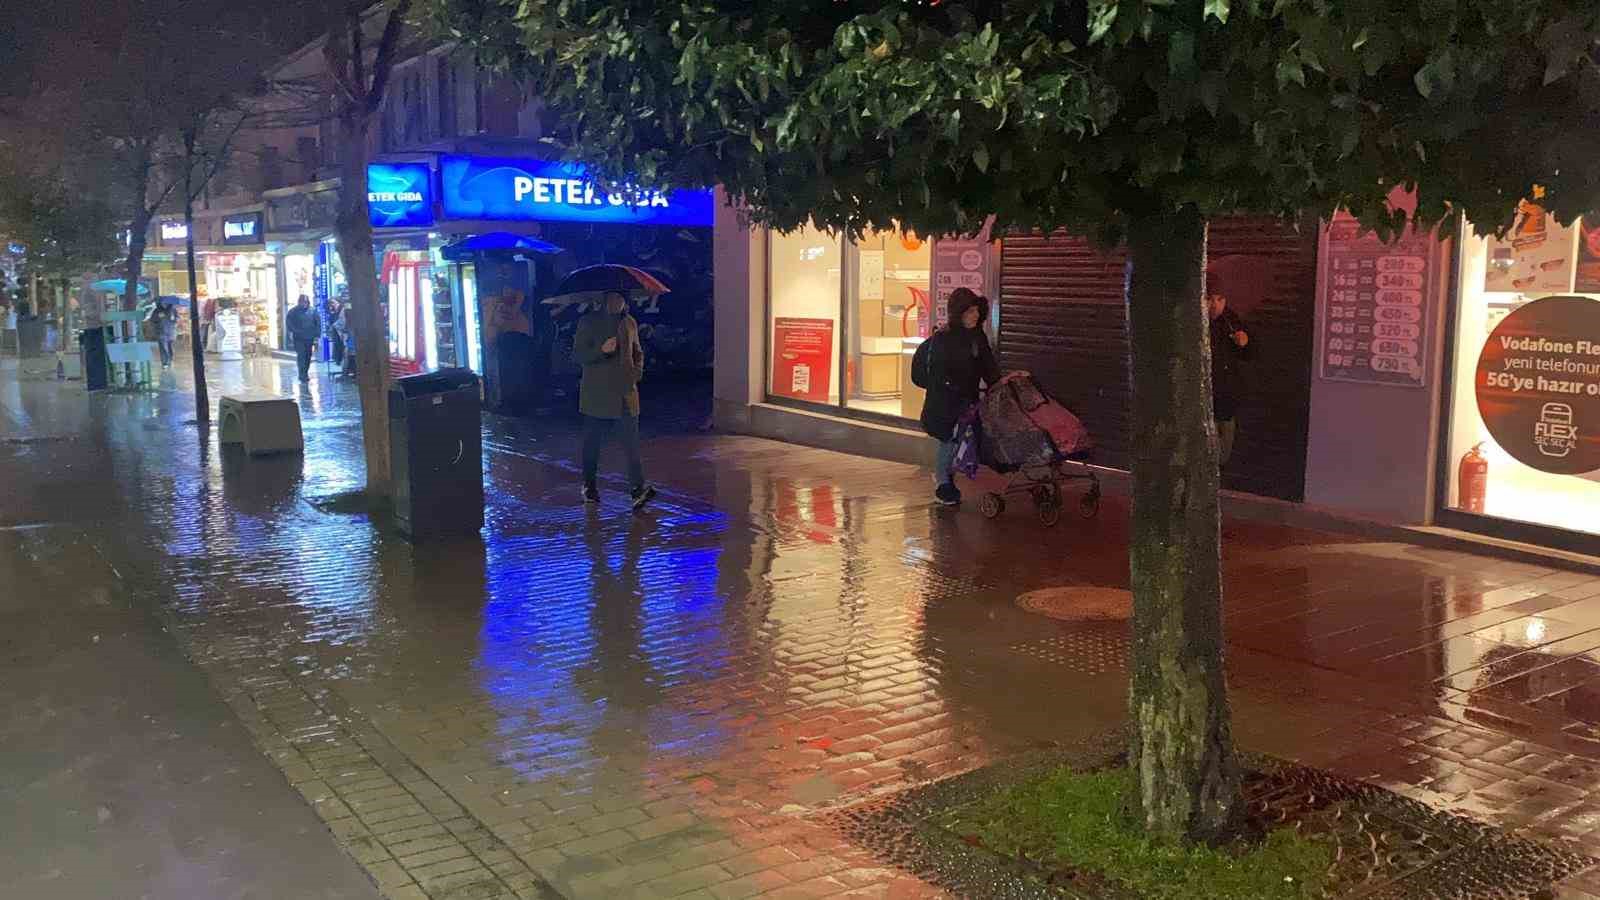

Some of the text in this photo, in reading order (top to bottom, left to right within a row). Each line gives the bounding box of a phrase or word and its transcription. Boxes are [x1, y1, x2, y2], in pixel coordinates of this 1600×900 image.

[368, 192, 395, 202] ETEK
[514, 177, 601, 204] PETEK
[1500, 336, 1600, 355] Vodafone Fle
[1503, 357, 1533, 370] yeni
[1487, 372, 1534, 392] 5G'ye
[1537, 376, 1584, 394] hazır
[1535, 422, 1578, 440] FLEX
